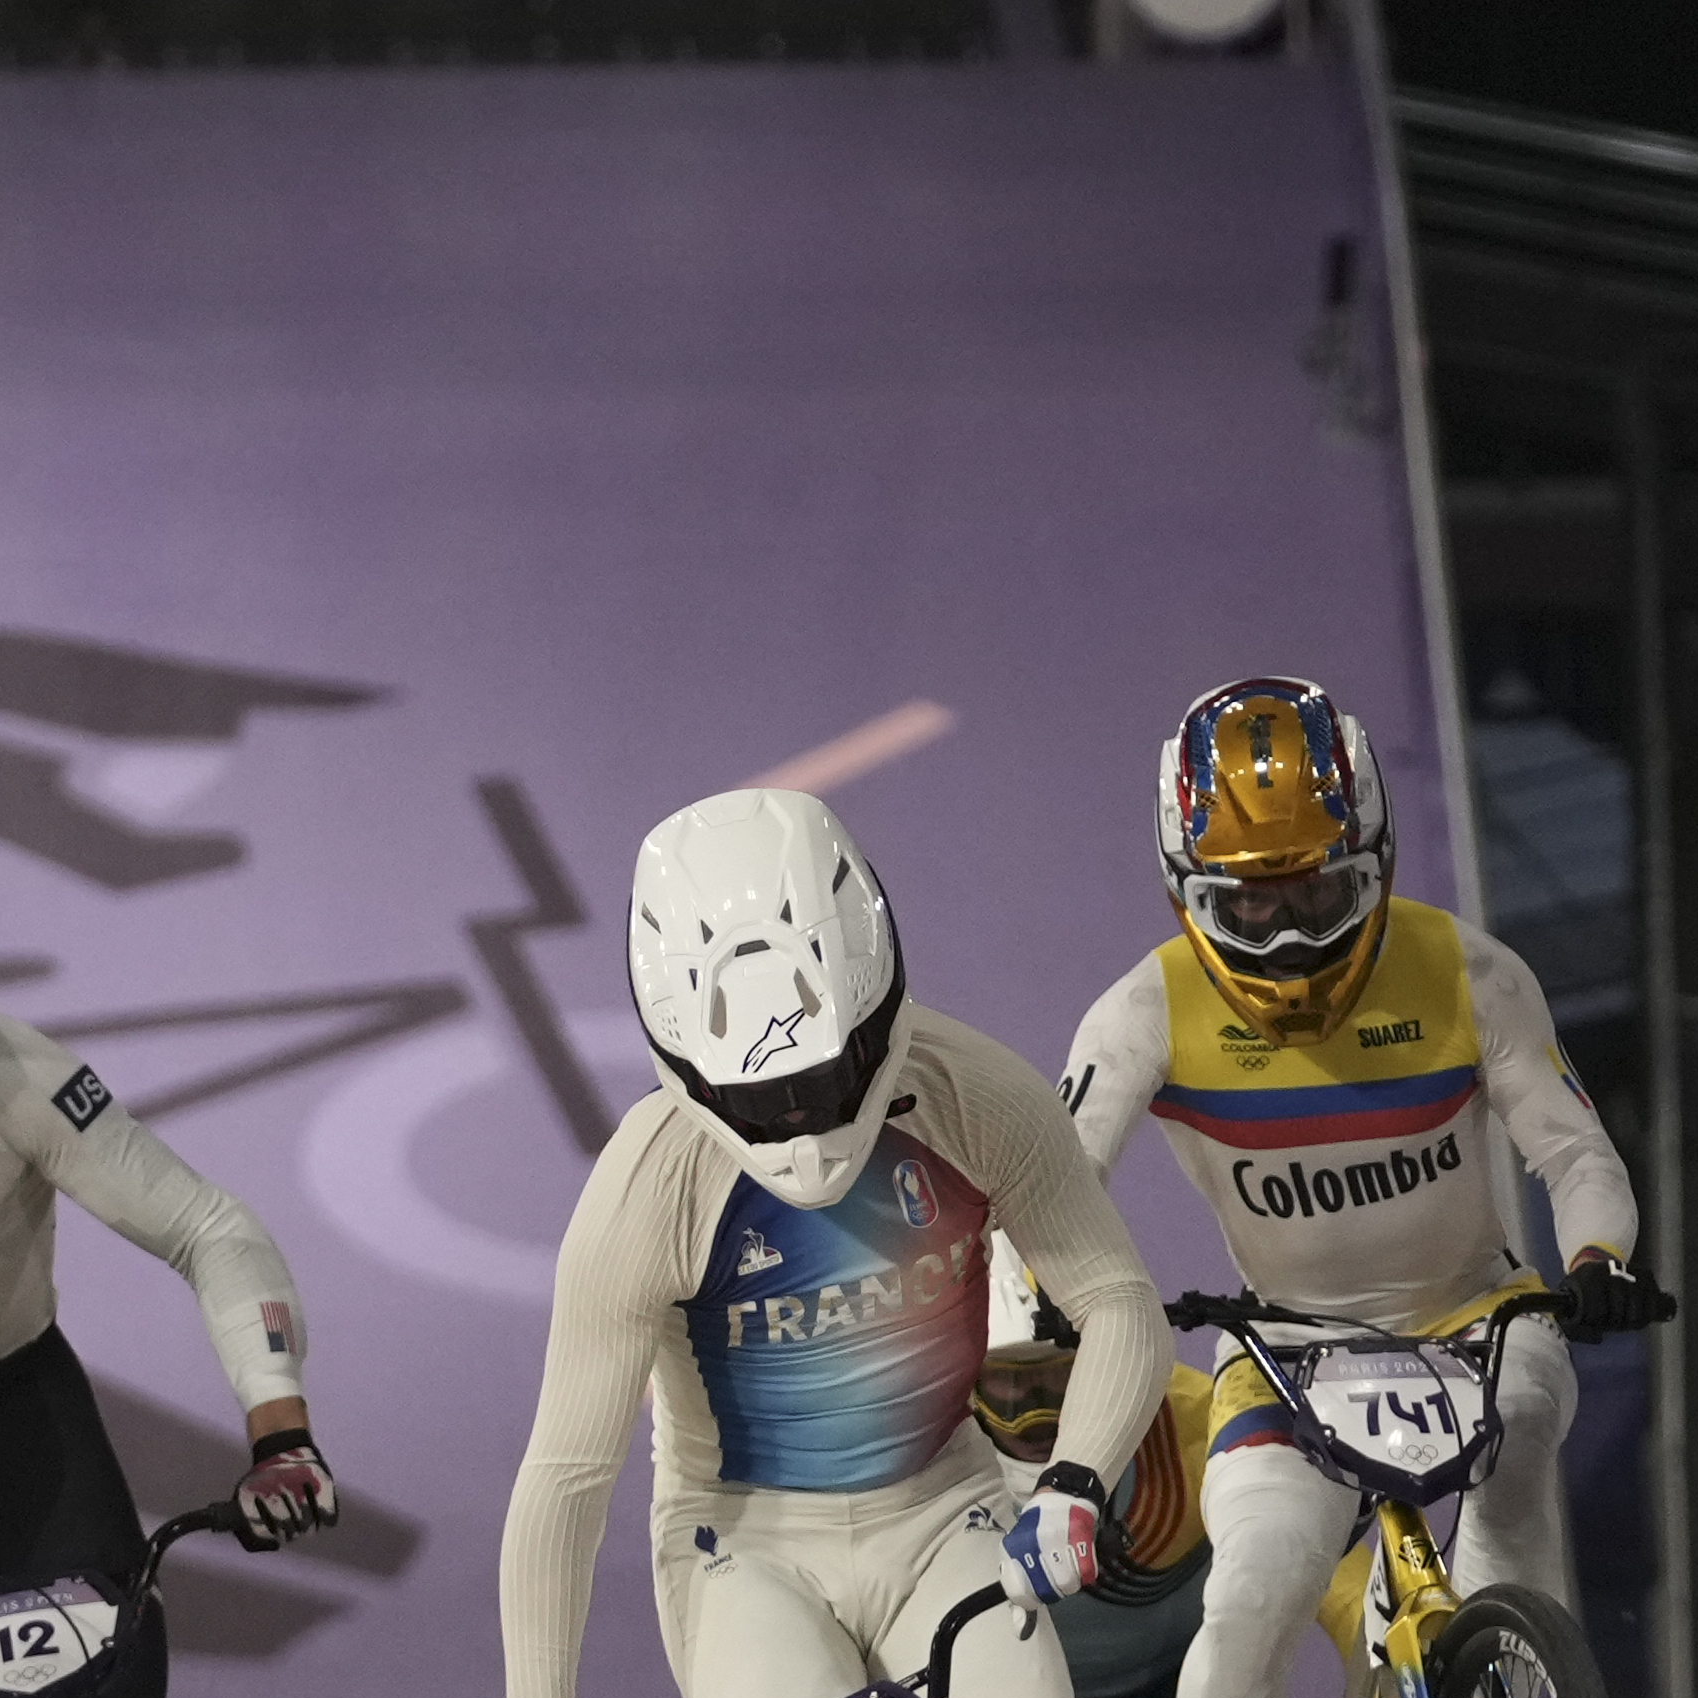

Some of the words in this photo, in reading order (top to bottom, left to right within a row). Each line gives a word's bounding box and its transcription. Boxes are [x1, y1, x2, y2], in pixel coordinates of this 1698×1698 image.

[1358, 1019, 1424, 1048] SUAREZ
[1232, 1132, 1462, 1218] Colombia
[727, 1233, 972, 1348] FRANCE
[1337, 1360, 1389, 1375] PARIS
[1347, 1391, 1455, 1436] 741
[703, 1551, 733, 1573] FRANCE
